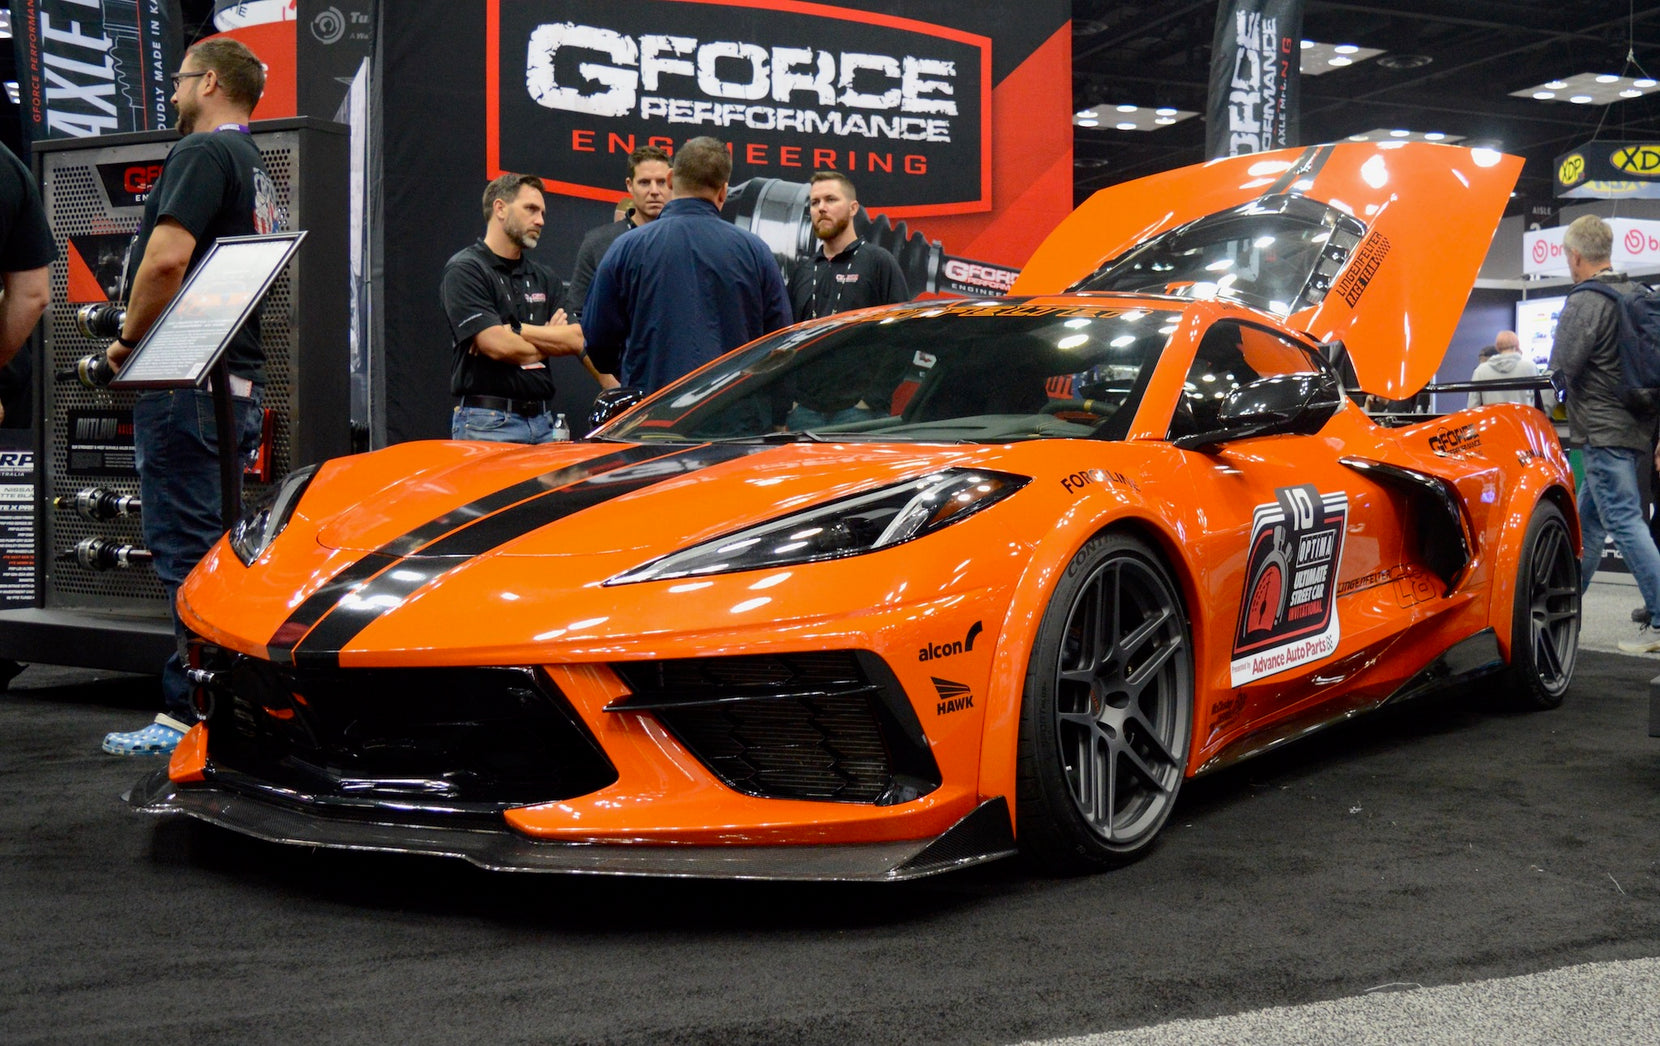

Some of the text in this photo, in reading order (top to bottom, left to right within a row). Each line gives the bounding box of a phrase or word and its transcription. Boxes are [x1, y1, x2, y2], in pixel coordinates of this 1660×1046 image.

[150, 21, 161, 40] IN
[151, 42, 165, 82] MADE
[526, 20, 959, 118] GFORCE
[640, 95, 953, 144] PERFORMANCE
[571, 129, 929, 176] ENGEERING
[1561, 157, 1582, 183] XDP
[1532, 206, 1551, 215] AISLE
[76, 417, 117, 440] OUTLAW
[1299, 534, 1332, 563] OPTIMA
[1293, 564, 1328, 590] ULTIMATE
[1289, 582, 1325, 607] STREET CAR
[918, 640, 963, 662] alcon
[1252, 652, 1284, 675] Advance
[1286, 647, 1306, 664] Auto
[1305, 637, 1327, 657] Parts
[936, 695, 974, 716] HAWK
